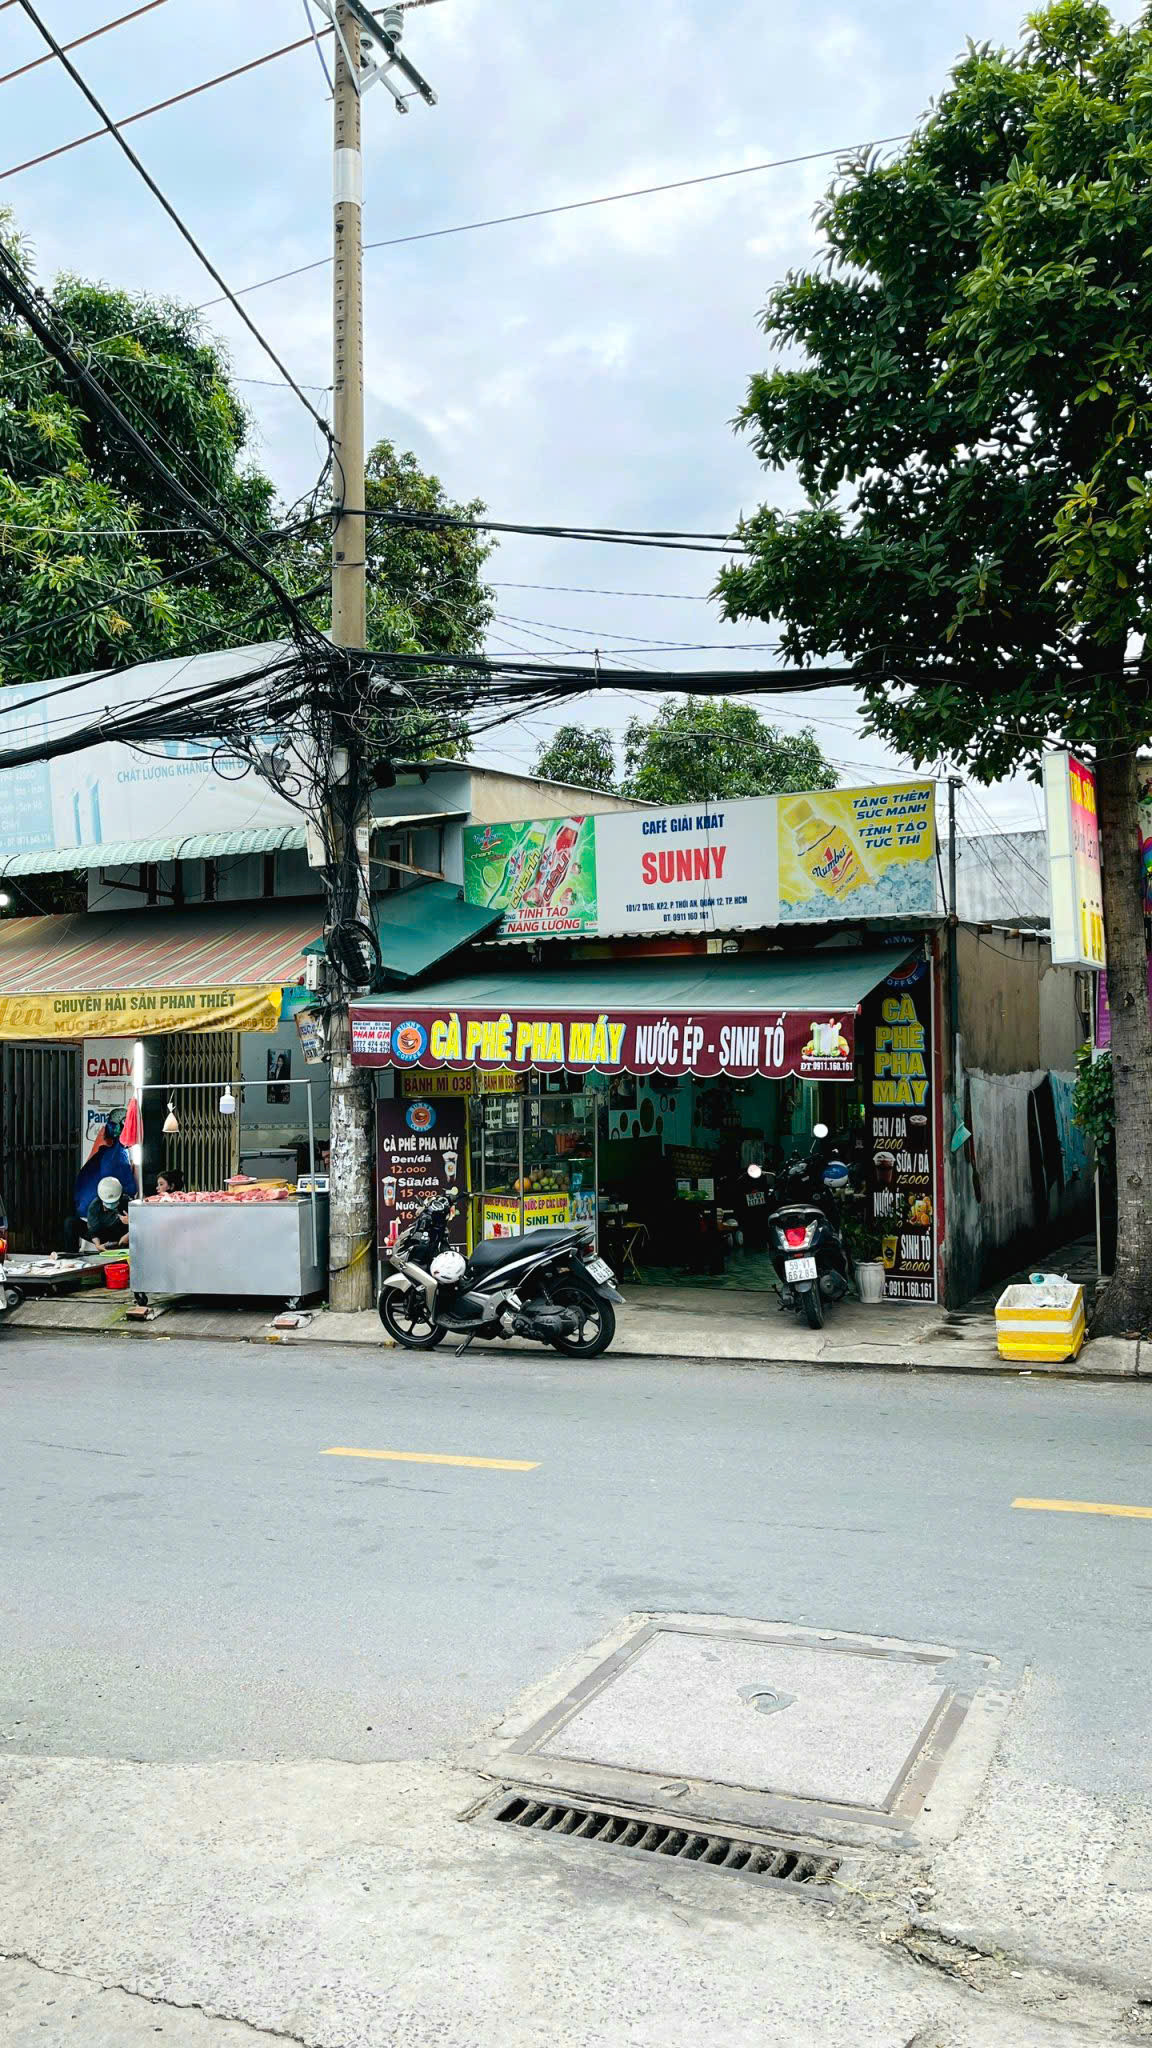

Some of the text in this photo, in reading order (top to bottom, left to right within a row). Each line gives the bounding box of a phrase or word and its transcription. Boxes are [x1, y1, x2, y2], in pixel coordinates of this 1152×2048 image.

[892, 789, 930, 803] THÊM
[670, 813, 693, 832] GIẢI
[642, 845, 727, 886] SUNNY
[734, 895, 748, 904] HCM
[53, 989, 236, 1013] CHUYÊN HẢI SẢN PHAN THIẾT
[882, 993, 917, 1023] CÀ
[430, 1012, 463, 1060] CÀ
[465, 1013, 513, 1062] PHÊ
[515, 1021, 566, 1063] PHA
[568, 1014, 627, 1064] MÁY
[634, 1016, 680, 1065] NƯỚC
[682, 1017, 705, 1066] ÉP
[718, 1025, 761, 1067] SINH
[764, 1012, 787, 1068] TỐ
[875, 1021, 925, 1051] PHÊ
[87, 1058, 134, 1077] CADIV
[874, 1051, 927, 1077] PHA
[404, 1073, 472, 1092] BÁNH MÌ 038
[872, 1077, 929, 1106] MÁY
[872, 1117, 889, 1137] ĐEN
[895, 1113, 907, 1138] ĐÁ
[383, 1132, 459, 1152] CÀ PHÊ PHA MÁY
[390, 1165, 427, 1174] 12.000
[896, 1149, 912, 1173] SỮA
[918, 1149, 930, 1174] ĐÁ
[400, 1188, 438, 1198] 15.000
[400, 1211, 417, 1220] 16.
[486, 1210, 517, 1223] SINH TỐ
[526, 1208, 565, 1227] SINH TỐ
[900, 1226, 932, 1262] SINH TỐ
[889, 1280, 932, 1298] 0911.160.161
